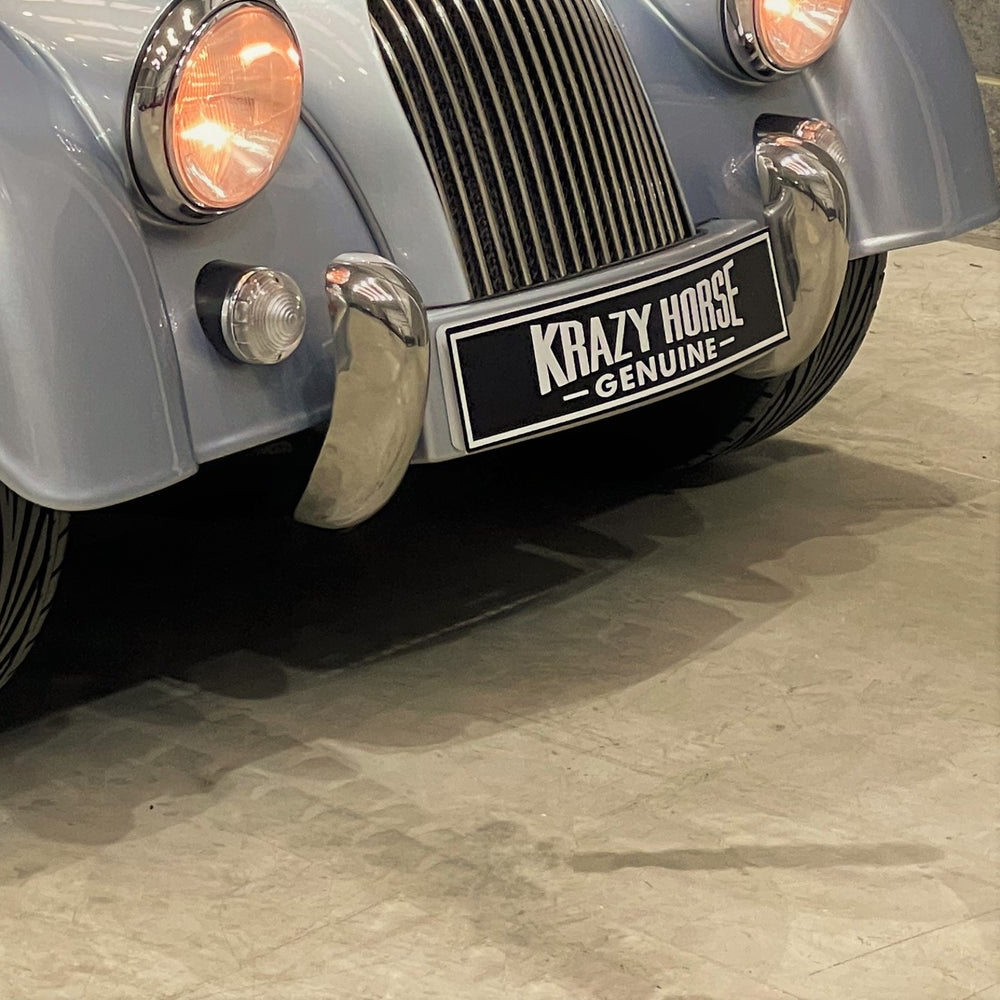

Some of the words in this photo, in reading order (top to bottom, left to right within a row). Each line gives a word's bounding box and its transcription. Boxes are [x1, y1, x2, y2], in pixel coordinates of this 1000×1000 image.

[529, 303, 652, 396] KRAZY
[659, 258, 744, 344] HORSE
[594, 337, 718, 398] GENUINE
